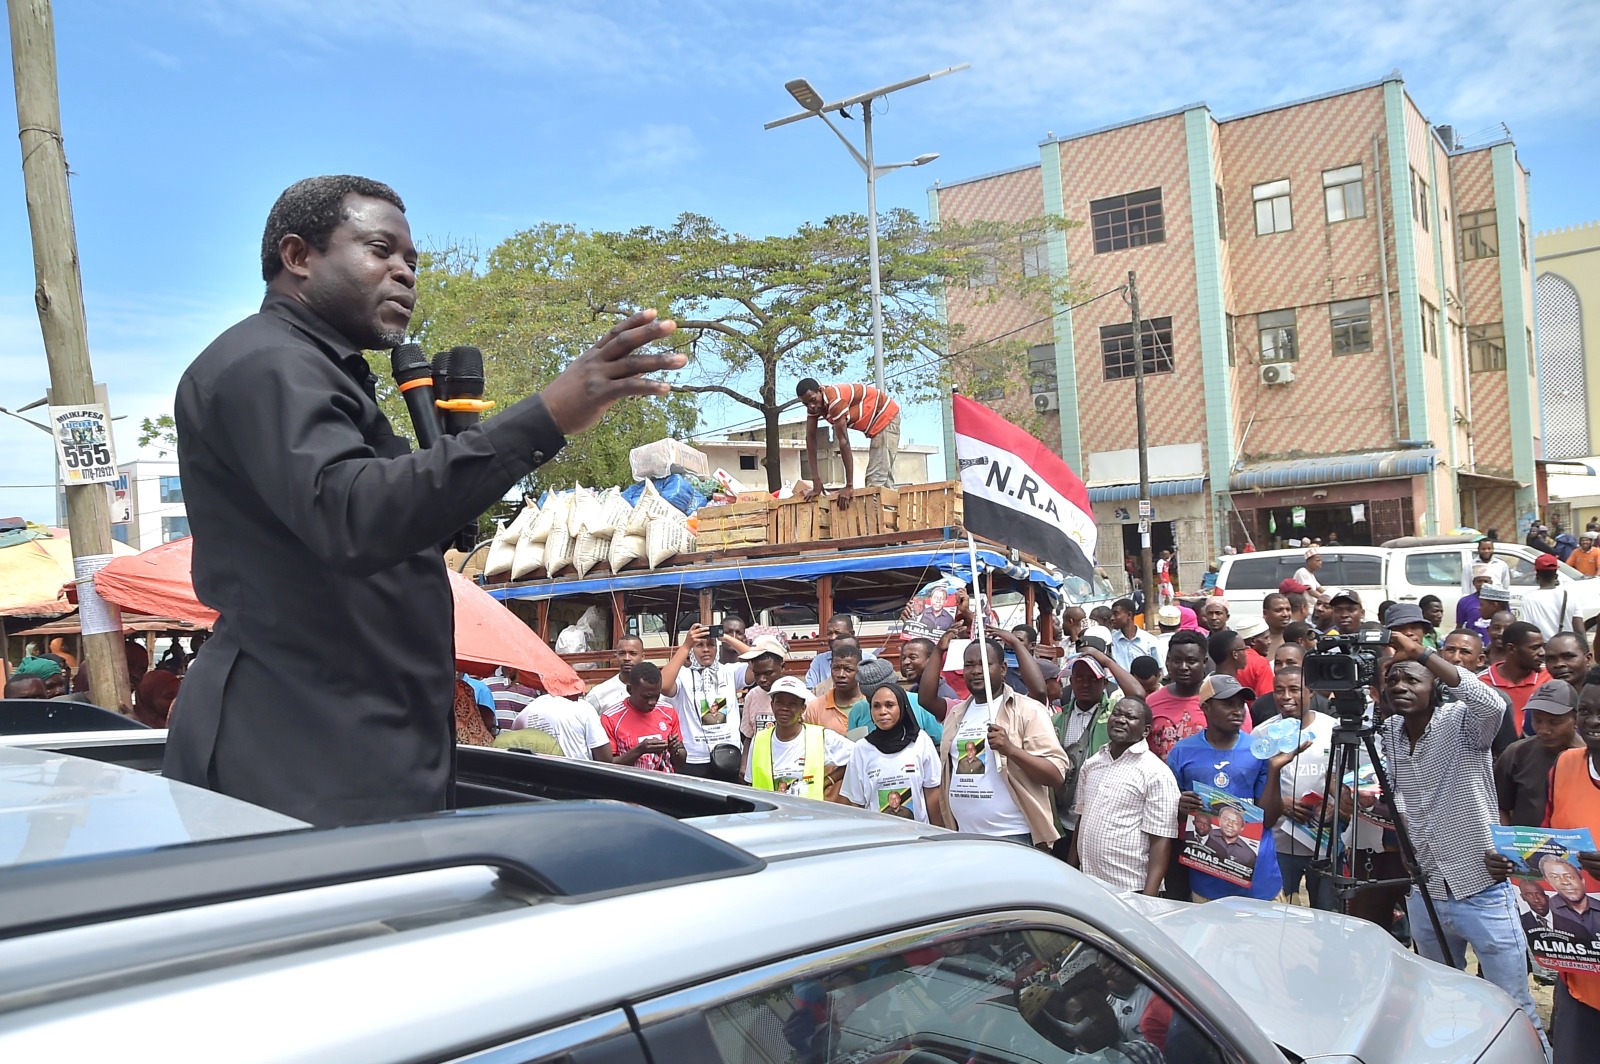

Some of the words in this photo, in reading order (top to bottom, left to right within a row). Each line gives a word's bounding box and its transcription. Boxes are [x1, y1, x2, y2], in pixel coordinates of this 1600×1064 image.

[63, 443, 111, 468] 555
[985, 460, 1060, 522] N.R.A
[1287, 763, 1328, 777] NZIBA
[1183, 846, 1220, 865] ALMAS
[1533, 939, 1587, 955] ALMAS
